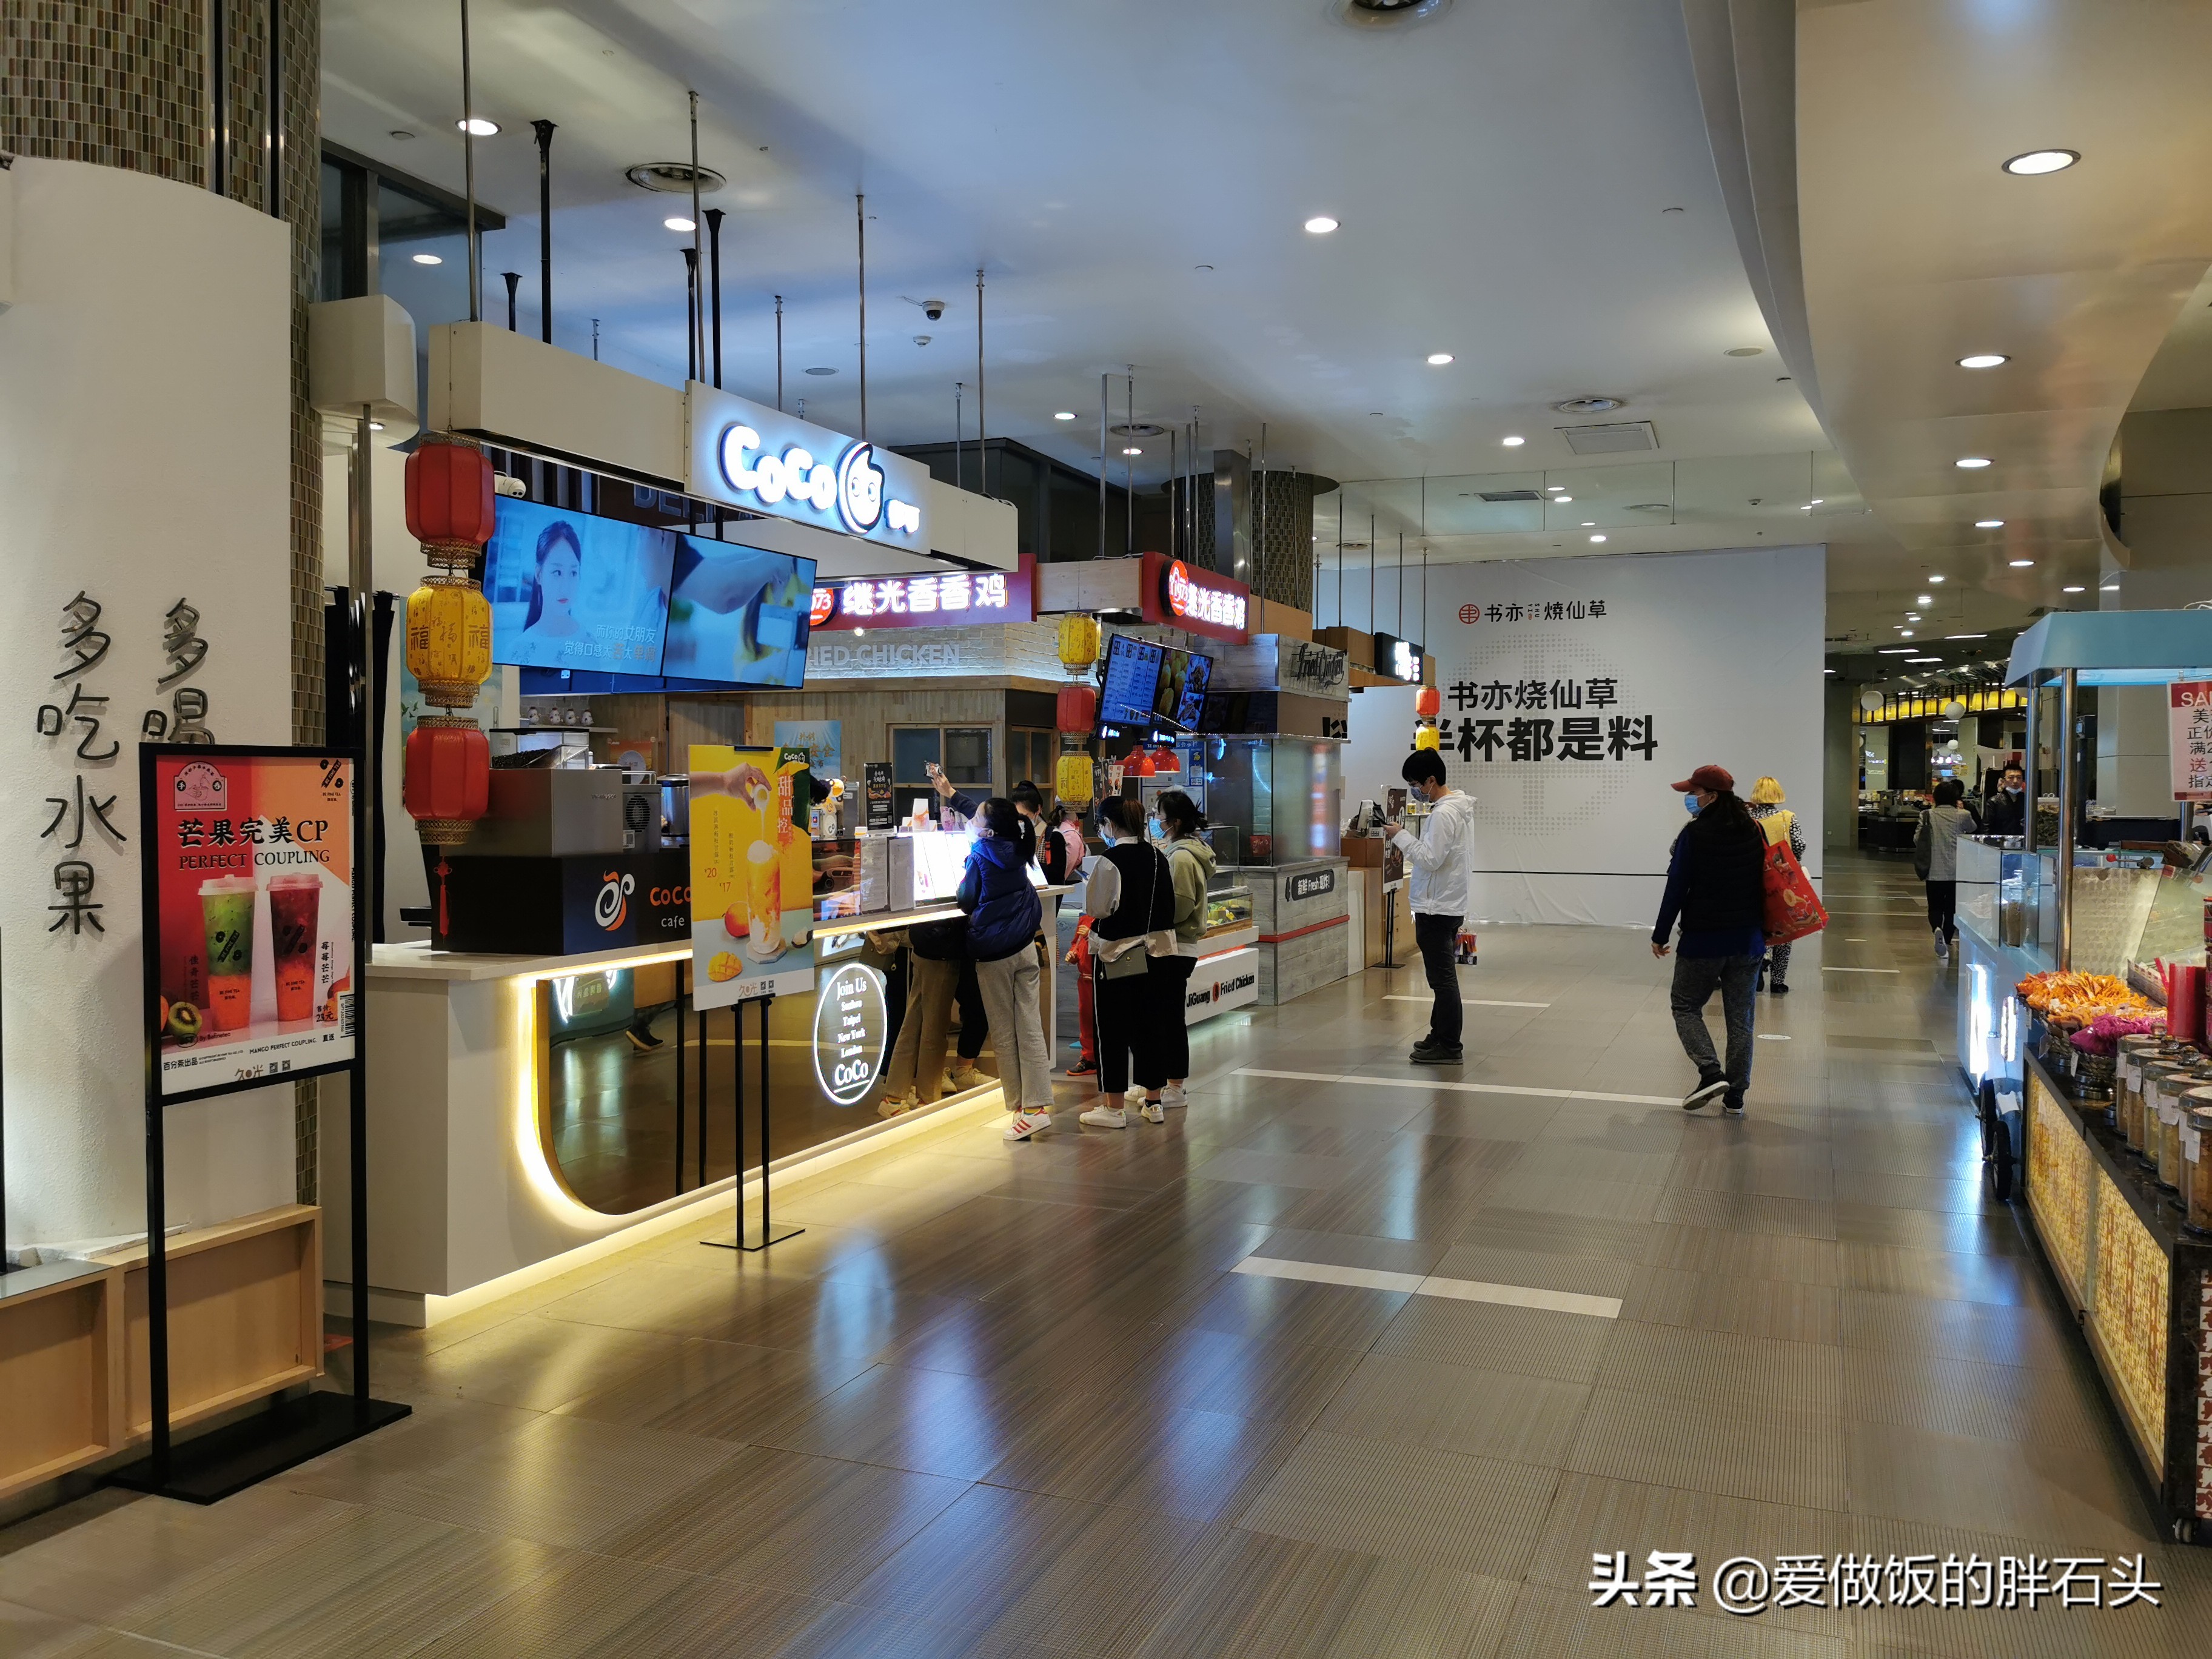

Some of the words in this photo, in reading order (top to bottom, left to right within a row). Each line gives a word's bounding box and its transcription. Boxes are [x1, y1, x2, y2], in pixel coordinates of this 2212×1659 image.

[597, 624, 656, 643] 而你的女朋友
[856, 644, 959, 666] CHICKEN
[1448, 678, 1618, 711] 书亦烧仙草
[2193, 709, 2212, 724] 美
[37, 591, 127, 934] 多吃水果
[777, 776, 793, 833] 甜品控
[178, 816, 329, 848] 芒果完美CP
[179, 853, 248, 870] PERFECT
[254, 850, 330, 866] COUPLING
[1308, 877, 1319, 892] Fresh
[661, 915, 685, 928] cafe
[837, 980, 854, 1000] Join
[855, 977, 866, 993] Us
[1221, 979, 1235, 995] Fried
[1235, 974, 1255, 990] Chicken
[250, 1045, 269, 1054] MANGO
[270, 1042, 290, 1051] PERFECT
[164, 1057, 198, 1071] 百分茶出品
[834, 1059, 869, 1086] CoCo
